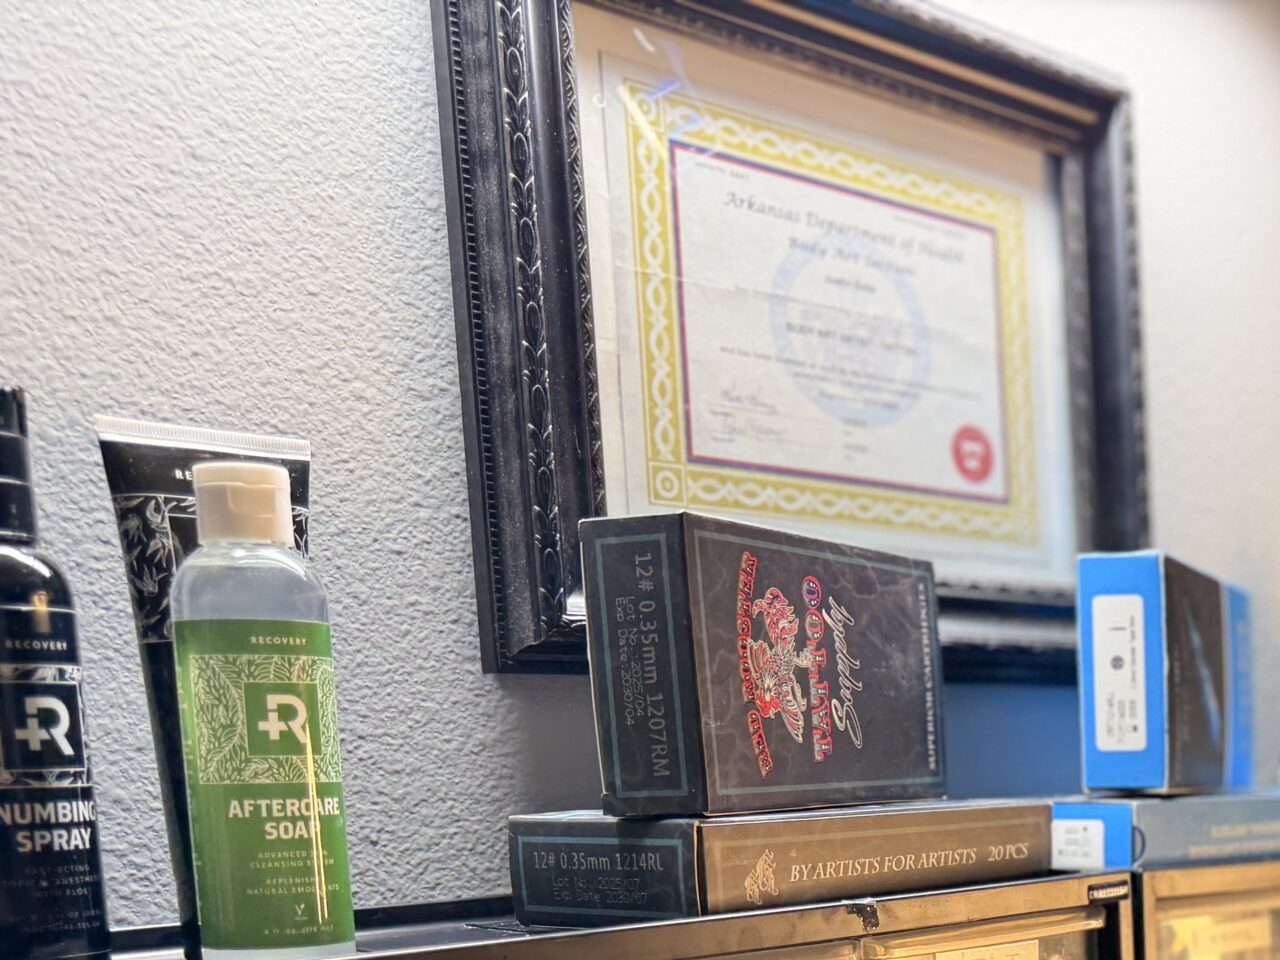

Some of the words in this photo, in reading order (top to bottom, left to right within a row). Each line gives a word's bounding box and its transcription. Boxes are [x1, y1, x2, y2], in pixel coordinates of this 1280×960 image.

[724, 191, 800, 224] Arkansas
[635, 553, 655, 592] 12#
[616, 597, 627, 622] Exp
[625, 597, 636, 621] Lot
[737, 551, 757, 704] ROOSTER
[5, 639, 68, 651] RECOVERY
[250, 635, 307, 646] RECOVERY
[638, 600, 659, 684] 0.35mm
[802, 575, 833, 763] TATTOO
[822, 596, 862, 749] Supply
[647, 692, 671, 777] 1207RM
[0, 801, 96, 826] NUMBING
[228, 797, 341, 819] AFTERCARE
[16, 827, 93, 853] SPRAY
[264, 821, 321, 841] SOAP
[250, 860, 304, 869] CLEANSING
[533, 851, 555, 869] 12#
[560, 852, 610, 871] 0.35mm
[616, 853, 664, 871] 1214RL
[789, 863, 814, 882] BY
[813, 856, 881, 880] ARTISTS
[884, 853, 916, 872] FOR
[918, 847, 977, 869] ARTISTS
[988, 844, 1004, 862] 20
[1005, 842, 1029, 860] PCS
